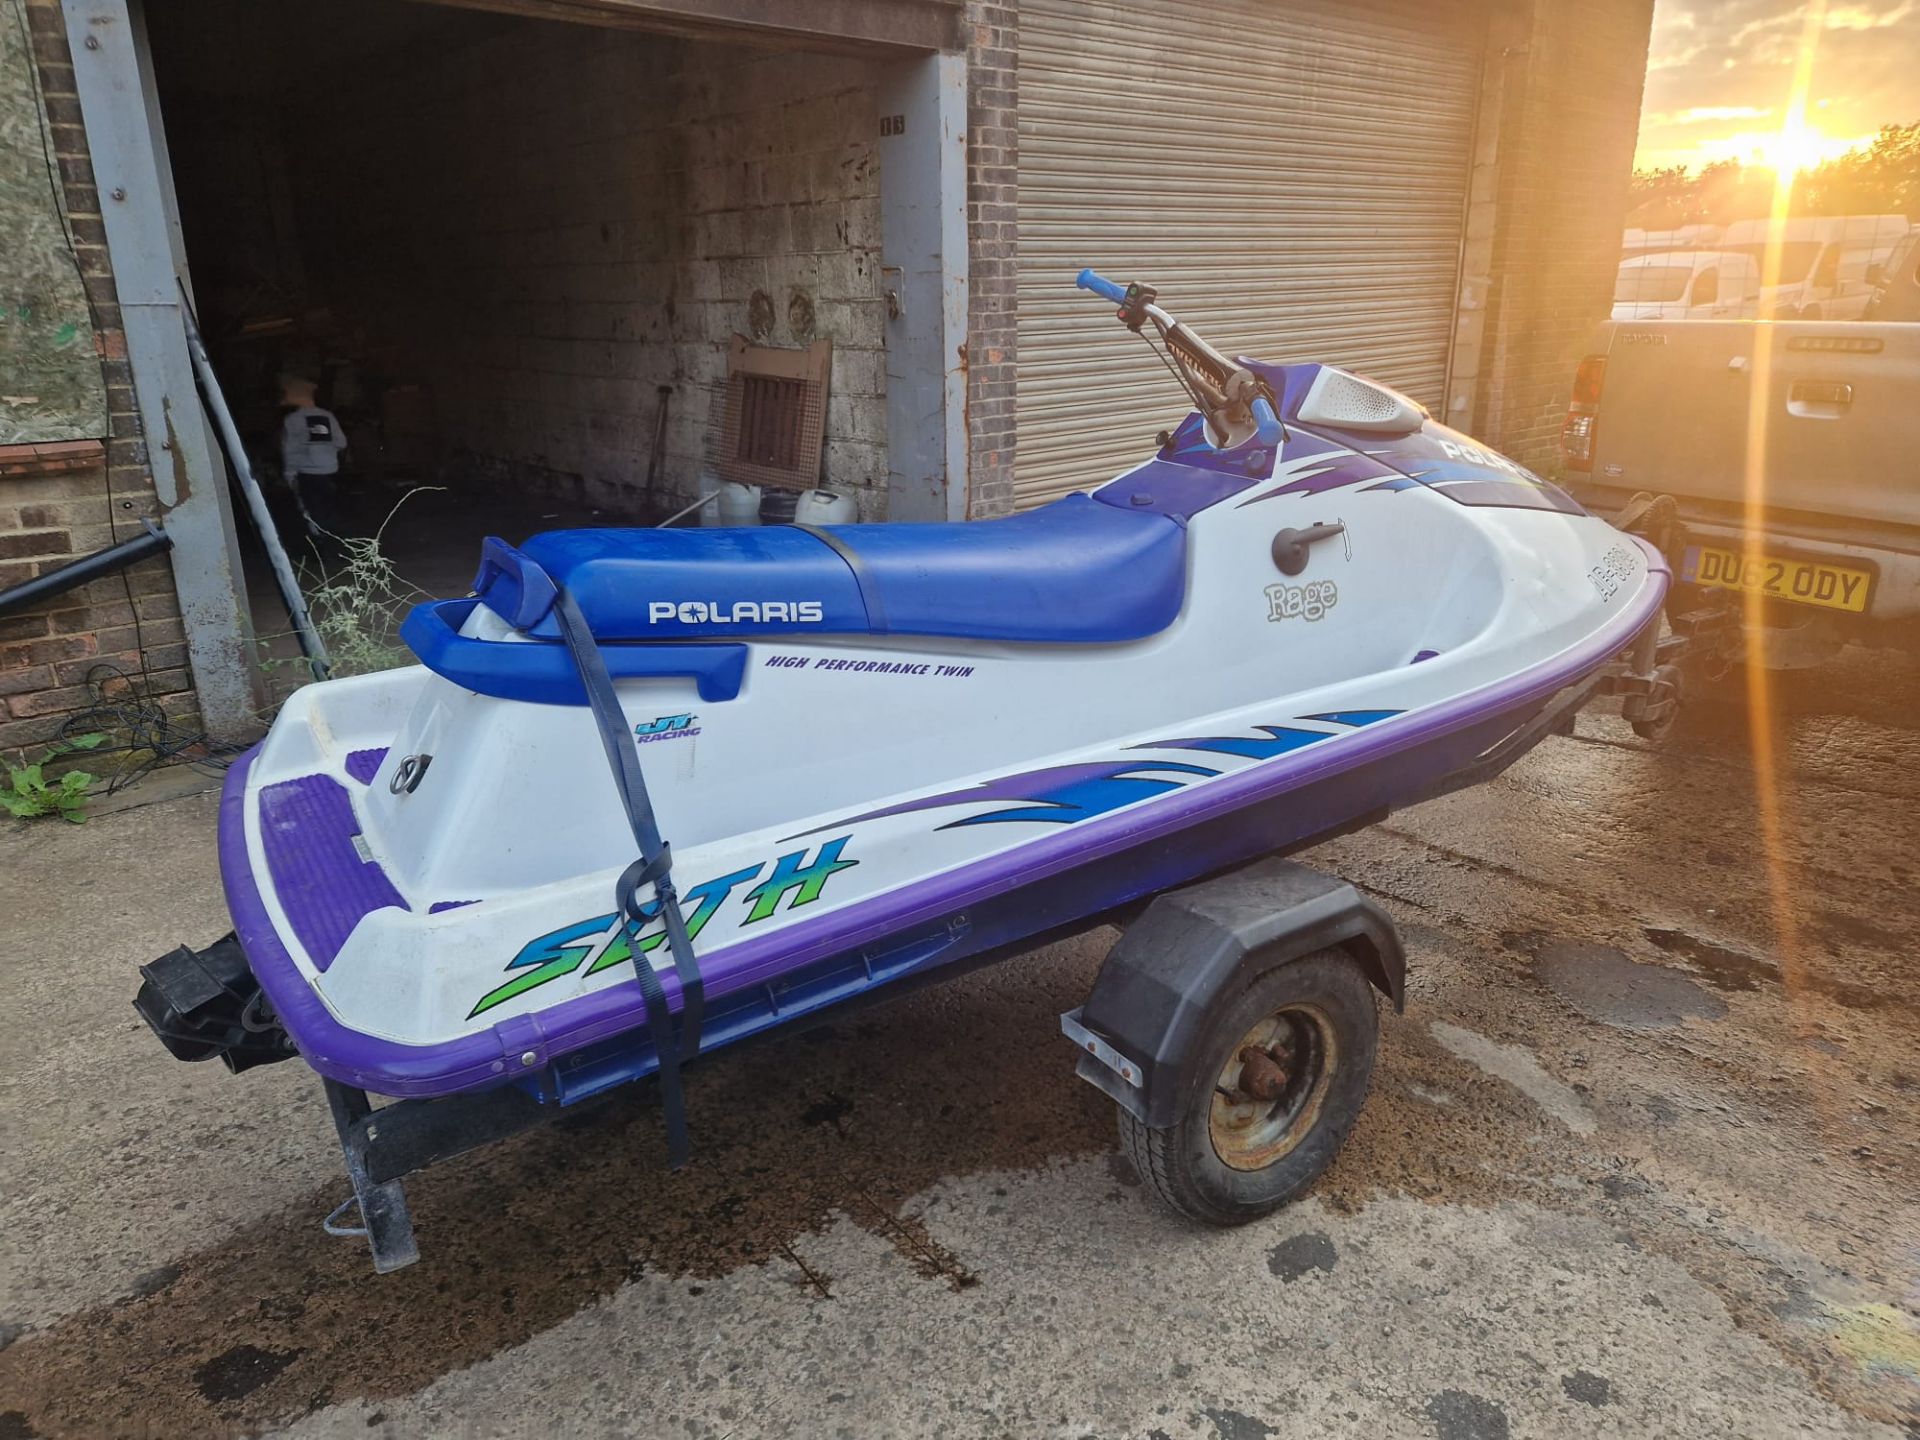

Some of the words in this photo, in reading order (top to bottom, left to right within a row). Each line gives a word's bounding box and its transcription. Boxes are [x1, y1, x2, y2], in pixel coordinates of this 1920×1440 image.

[1700, 552, 1784, 592] DU62
[1792, 565, 1862, 605] ODY
[648, 601, 823, 624] POLARIS
[1263, 580, 1337, 622] Rage
[766, 656, 810, 669] HIGH
[815, 657, 930, 676] PERFORMANCE
[933, 664, 975, 678] TWIN
[637, 727, 702, 743] RACING
